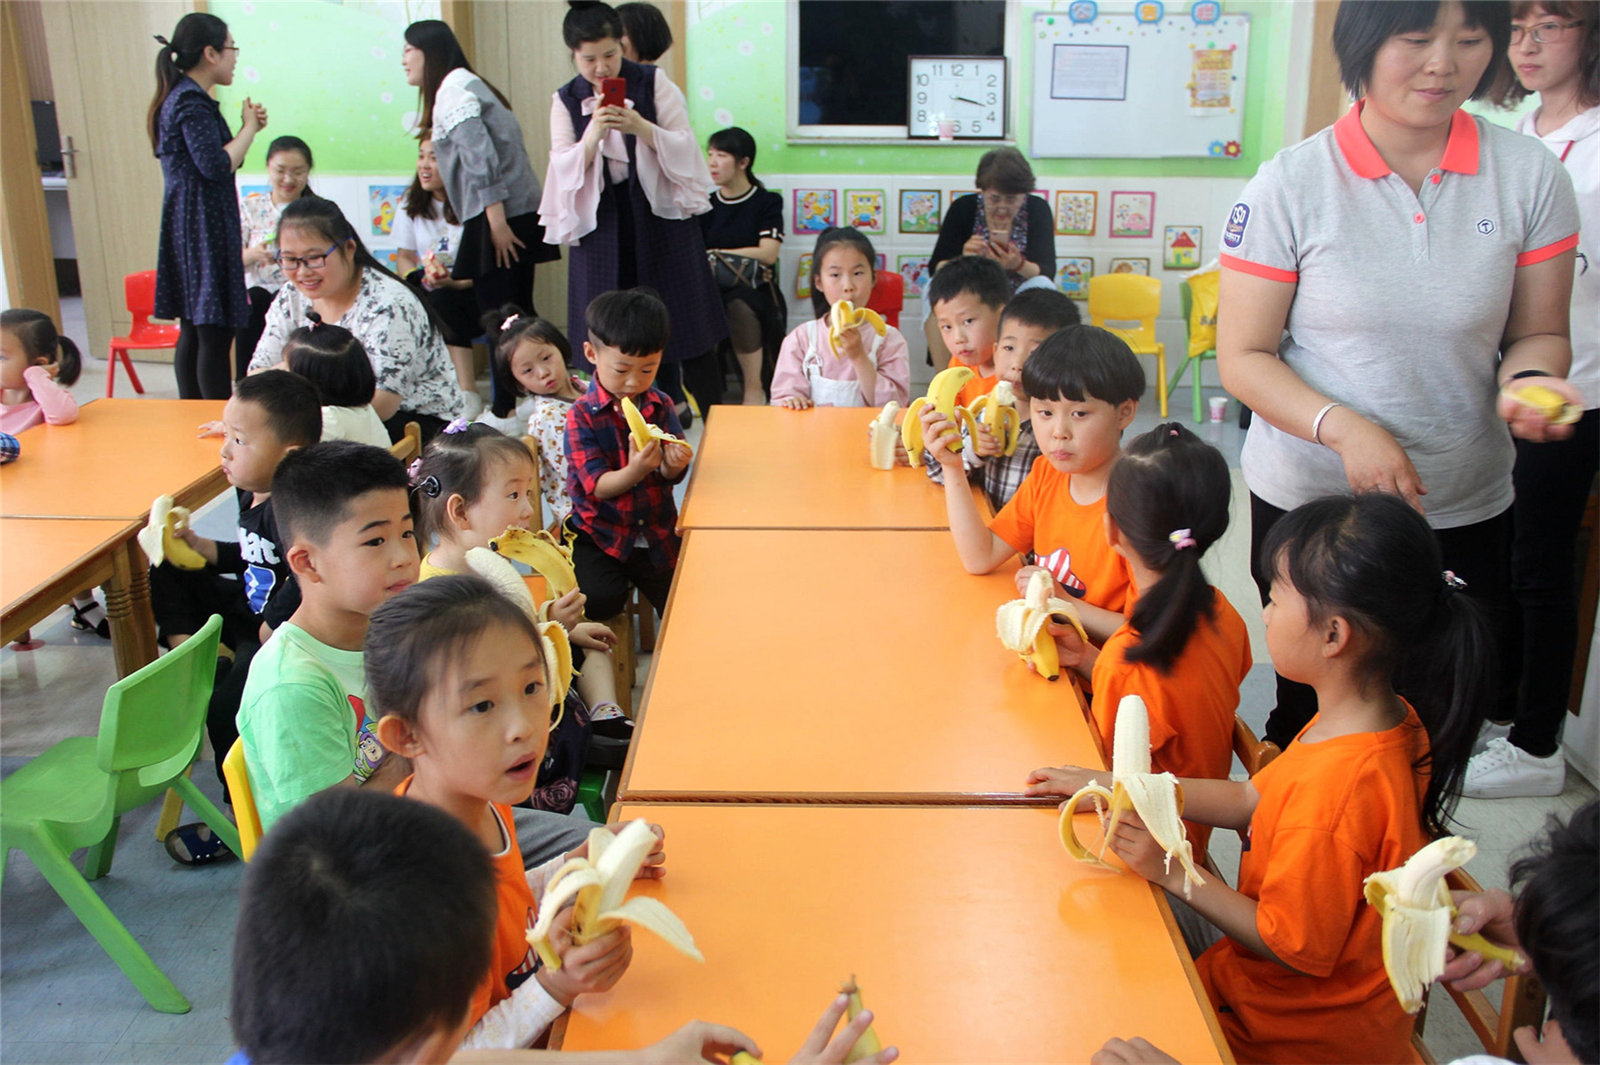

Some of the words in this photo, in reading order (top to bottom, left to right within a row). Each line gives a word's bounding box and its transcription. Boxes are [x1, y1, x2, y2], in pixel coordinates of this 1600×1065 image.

[932, 64, 943, 76] 11
[950, 63, 964, 77] 12
[974, 64, 979, 76] 1
[916, 73, 929, 87] 10
[986, 74, 997, 87] 2
[916, 91, 928, 105] 9
[986, 92, 997, 105] 3
[916, 109, 927, 123] 8
[986, 110, 996, 122] 4
[971, 120, 982, 133] 5
